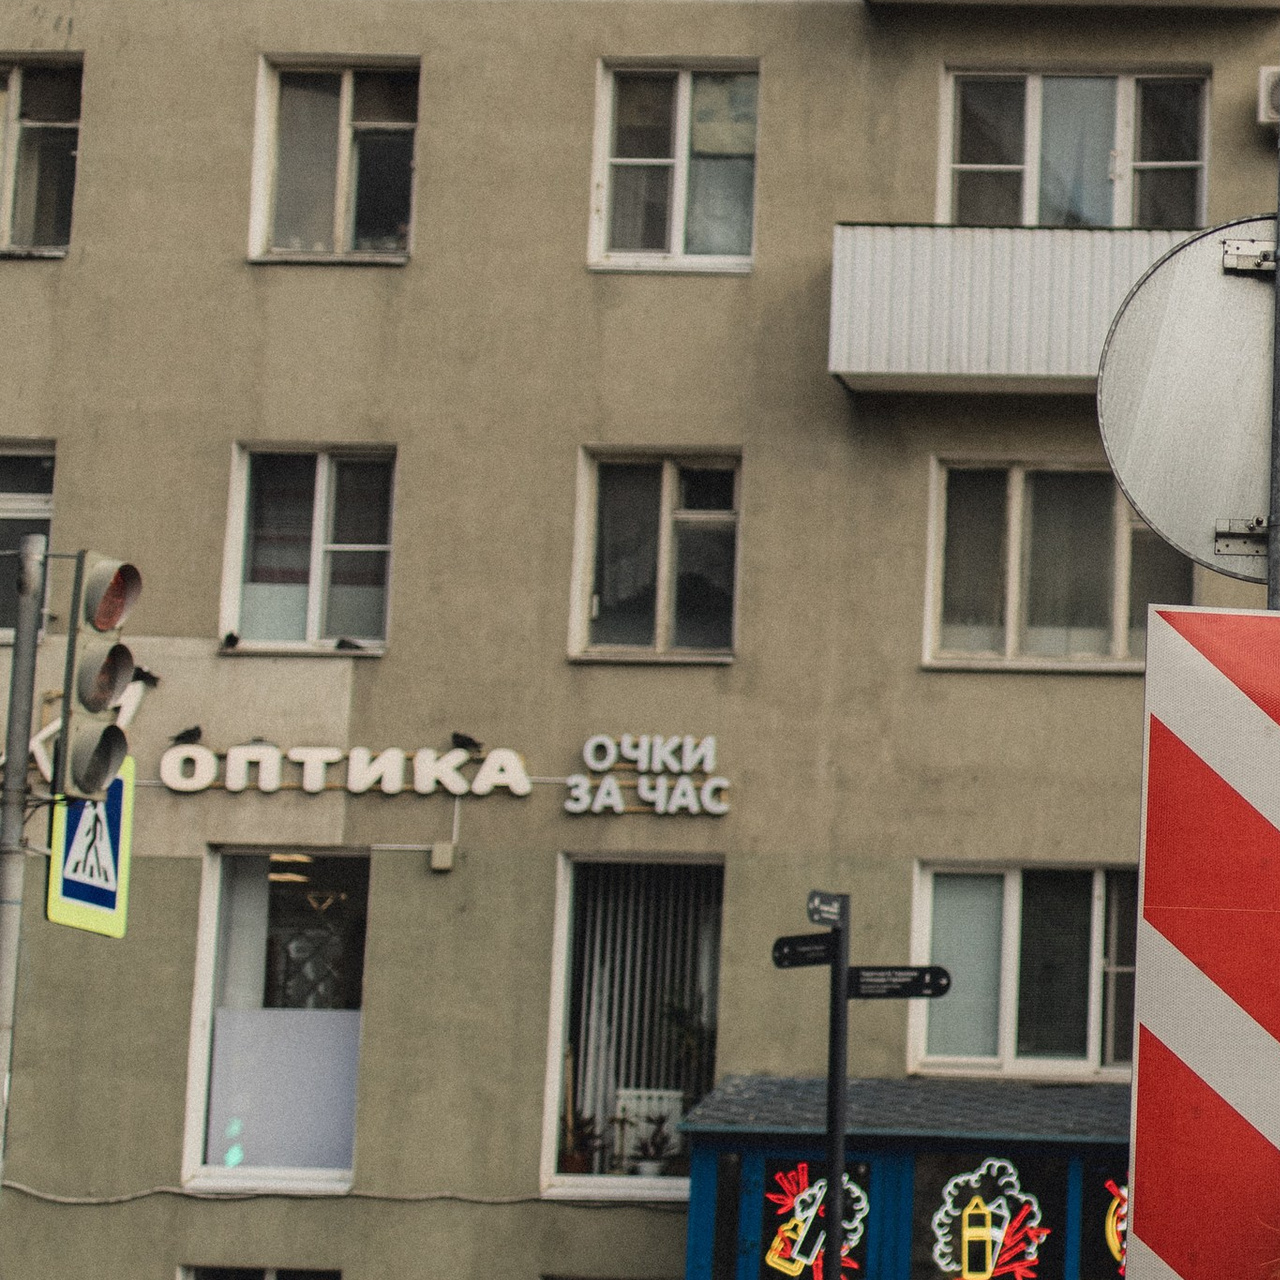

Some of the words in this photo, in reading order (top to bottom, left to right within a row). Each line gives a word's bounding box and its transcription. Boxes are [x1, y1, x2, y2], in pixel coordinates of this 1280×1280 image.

[160, 743, 533, 797] ОПТИКА
[583, 733, 716, 773] ОЧКИ
[564, 774, 625, 814] ЗА
[637, 775, 731, 815] ЧАС
